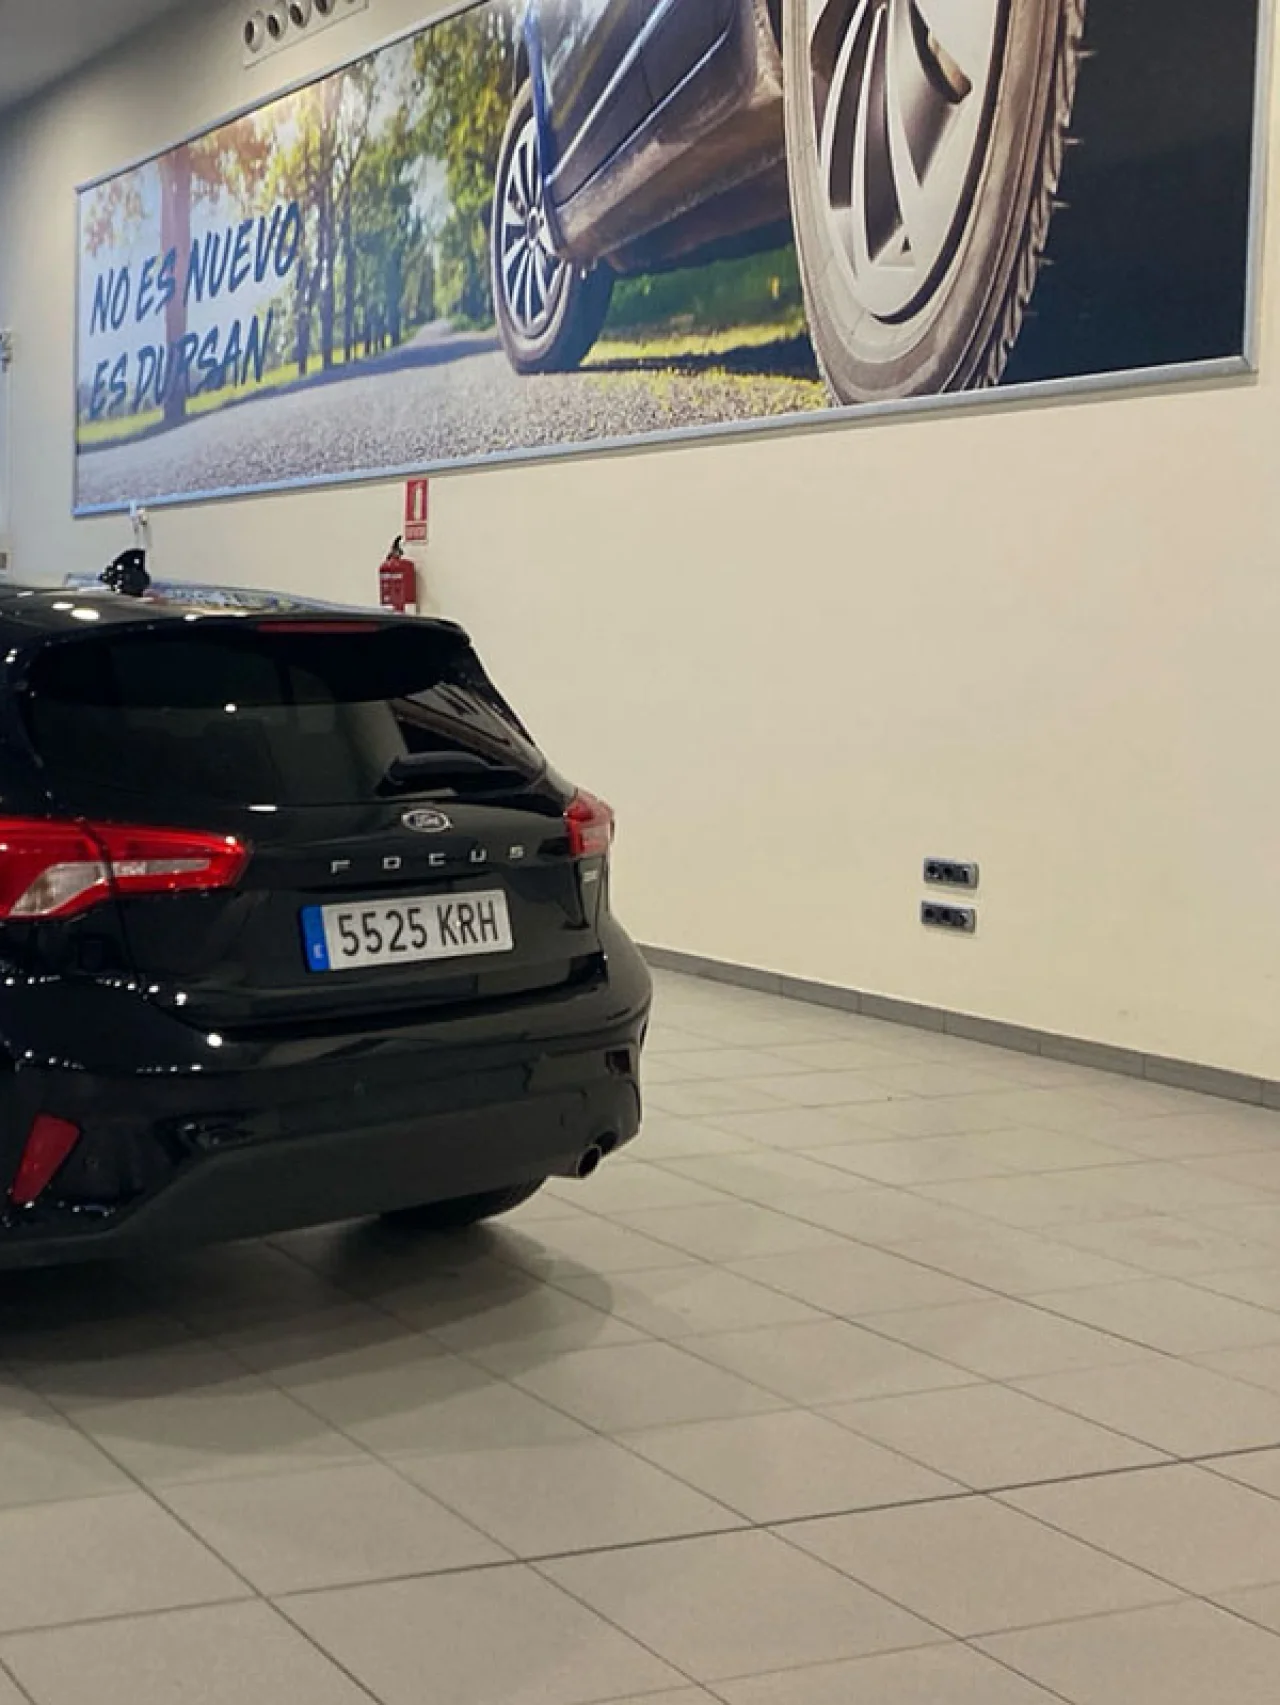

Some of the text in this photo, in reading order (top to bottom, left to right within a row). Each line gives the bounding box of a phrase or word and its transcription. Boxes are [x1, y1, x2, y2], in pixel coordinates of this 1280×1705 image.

[90, 265, 131, 335] NO
[136, 248, 177, 322] ES
[89, 307, 274, 421] ES DURSAN
[330, 845, 524, 874] FOCUS
[338, 900, 498, 957] 5525 KRH
